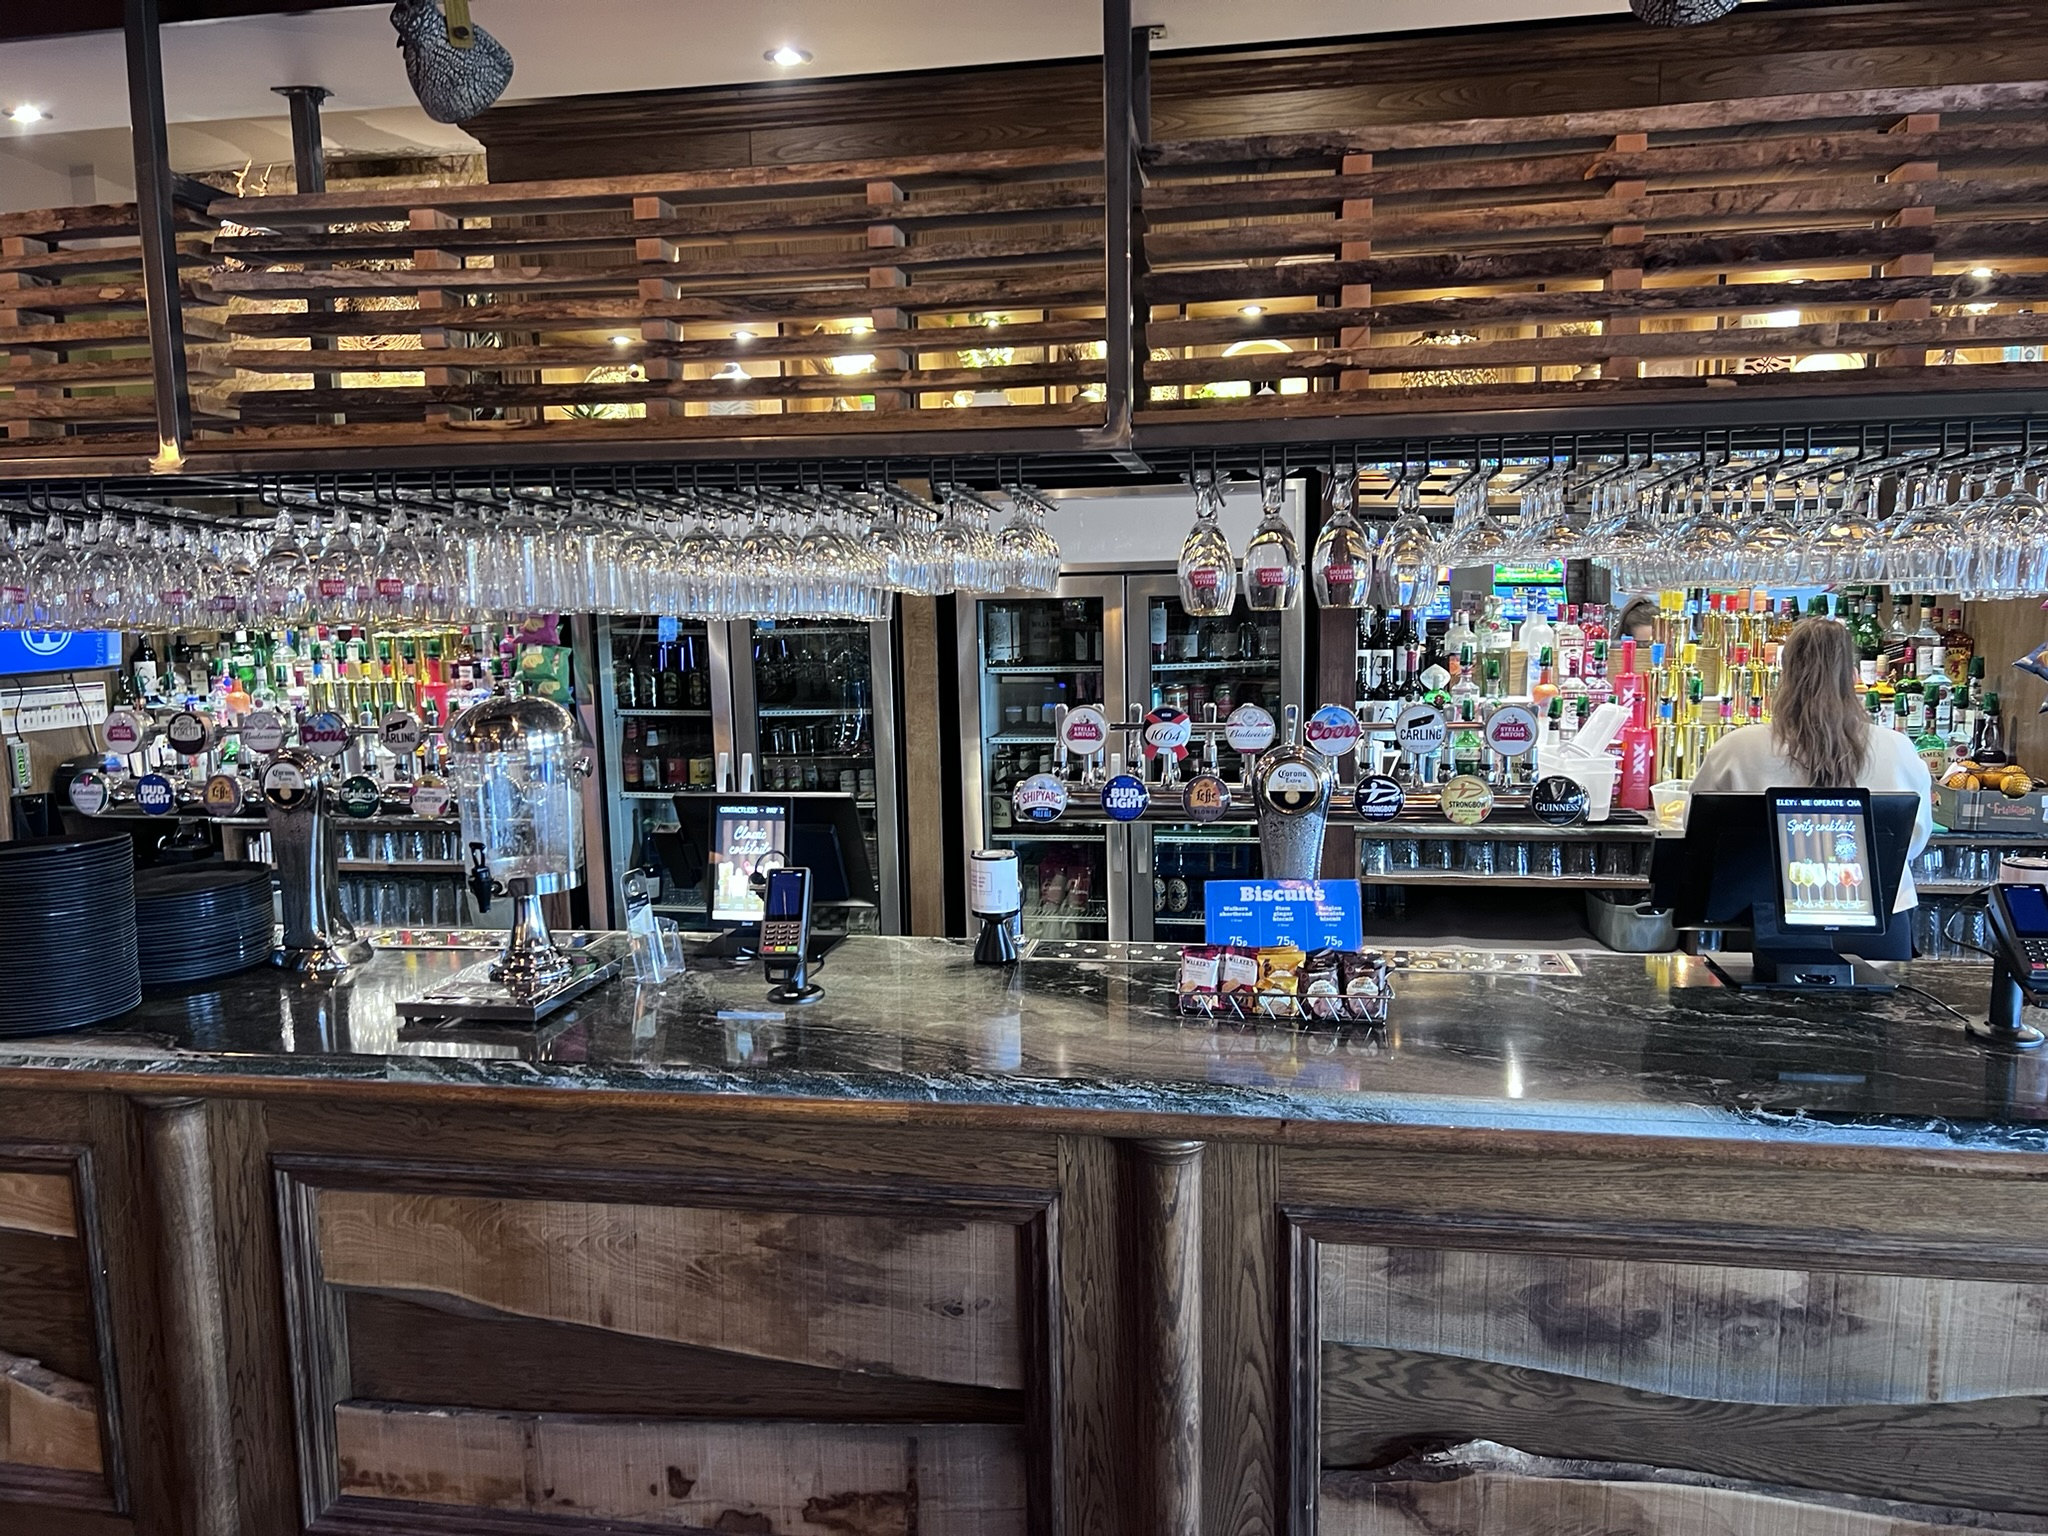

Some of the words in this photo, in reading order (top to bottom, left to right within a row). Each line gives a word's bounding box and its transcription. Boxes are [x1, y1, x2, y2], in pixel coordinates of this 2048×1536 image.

[301, 725, 348, 743] Coors
[1150, 729, 1182, 742] 1664
[1229, 729, 1272, 739] Budweiser
[1308, 721, 1361, 741] Coors
[1400, 728, 1442, 740] CARLING
[381, 732, 415, 743] CARLING
[1277, 769, 1308, 779] Corona
[140, 784, 166, 793] BUD
[1110, 787, 1138, 798] BUD
[137, 793, 171, 804] LIGHT
[1022, 790, 1062, 804] SHIPYARD
[1196, 788, 1217, 804] Leffe
[1106, 797, 1144, 808] LIGHT
[1448, 800, 1486, 808] STRONGBOW
[1535, 802, 1580, 812] GUINNESS
[1813, 799, 1844, 807] OPERATE
[1362, 804, 1398, 813] STRONGBOW
[1815, 818, 1856, 832] cocktails
[733, 825, 768, 841] Classic
[1240, 885, 1326, 902] Biscuits
[1229, 936, 1248, 947] 75p
[1276, 936, 1296, 946] 75p
[1324, 935, 1343, 947] 75p
